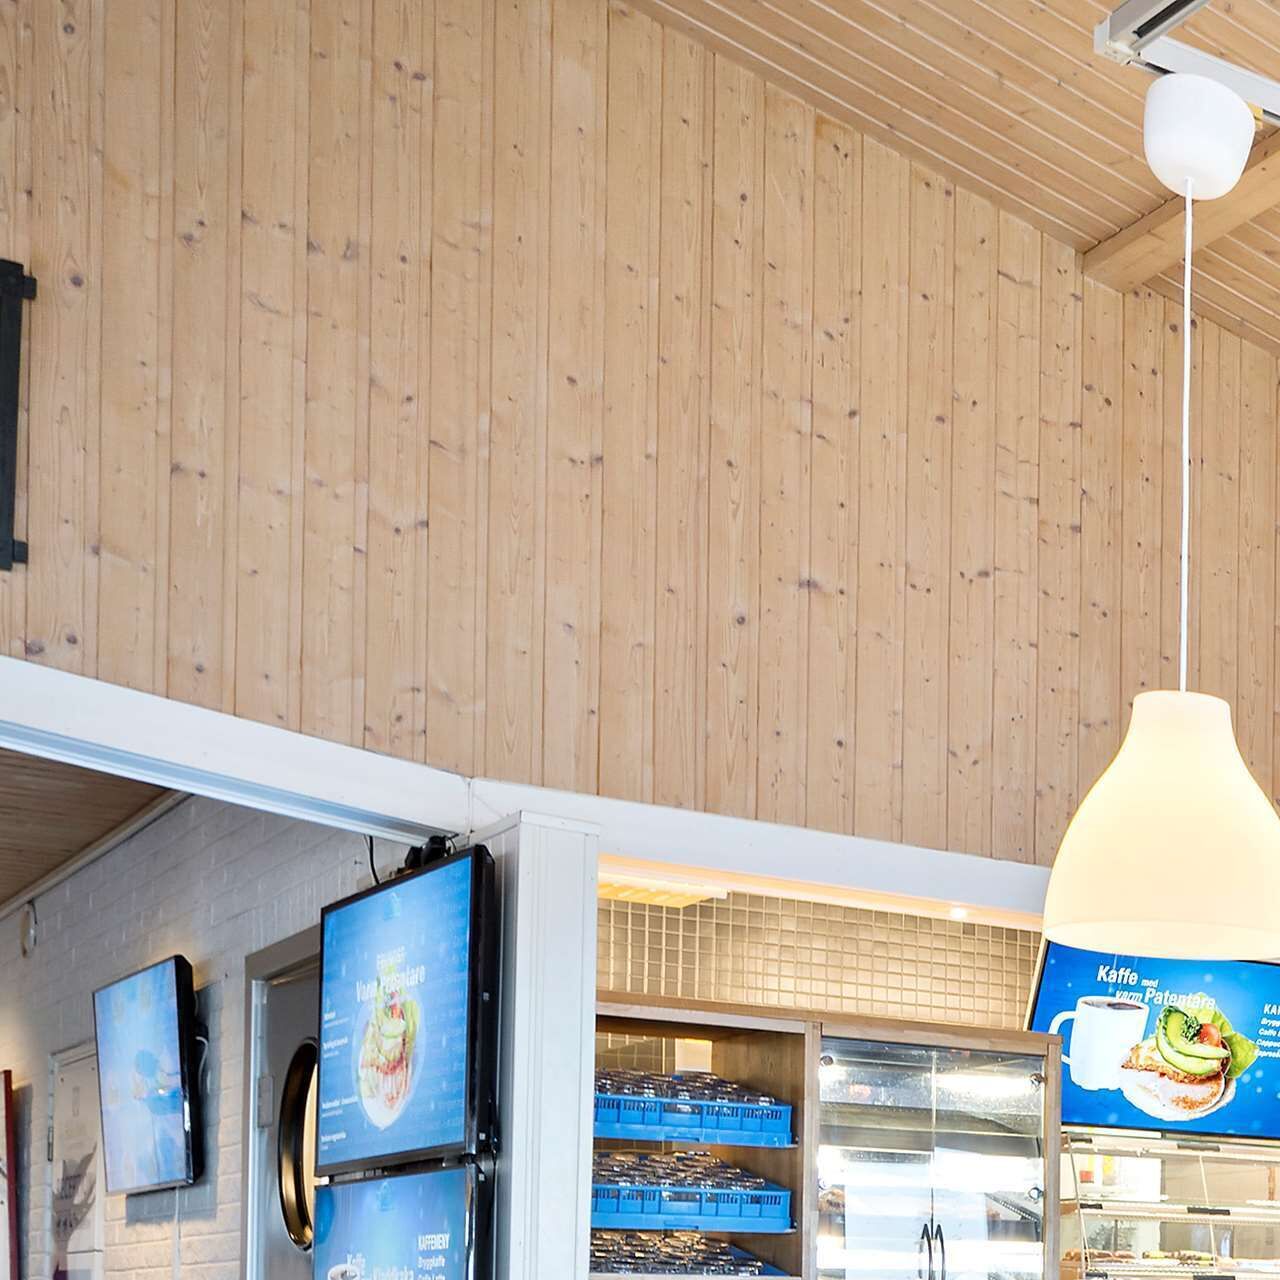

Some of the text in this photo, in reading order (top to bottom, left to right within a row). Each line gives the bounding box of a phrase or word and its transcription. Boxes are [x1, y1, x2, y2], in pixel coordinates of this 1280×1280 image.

[1097, 965, 1159, 988] Kaffe med
[1115, 988, 1217, 1009] varm Patentare
[417, 1232, 451, 1251] KAFFEMENY
